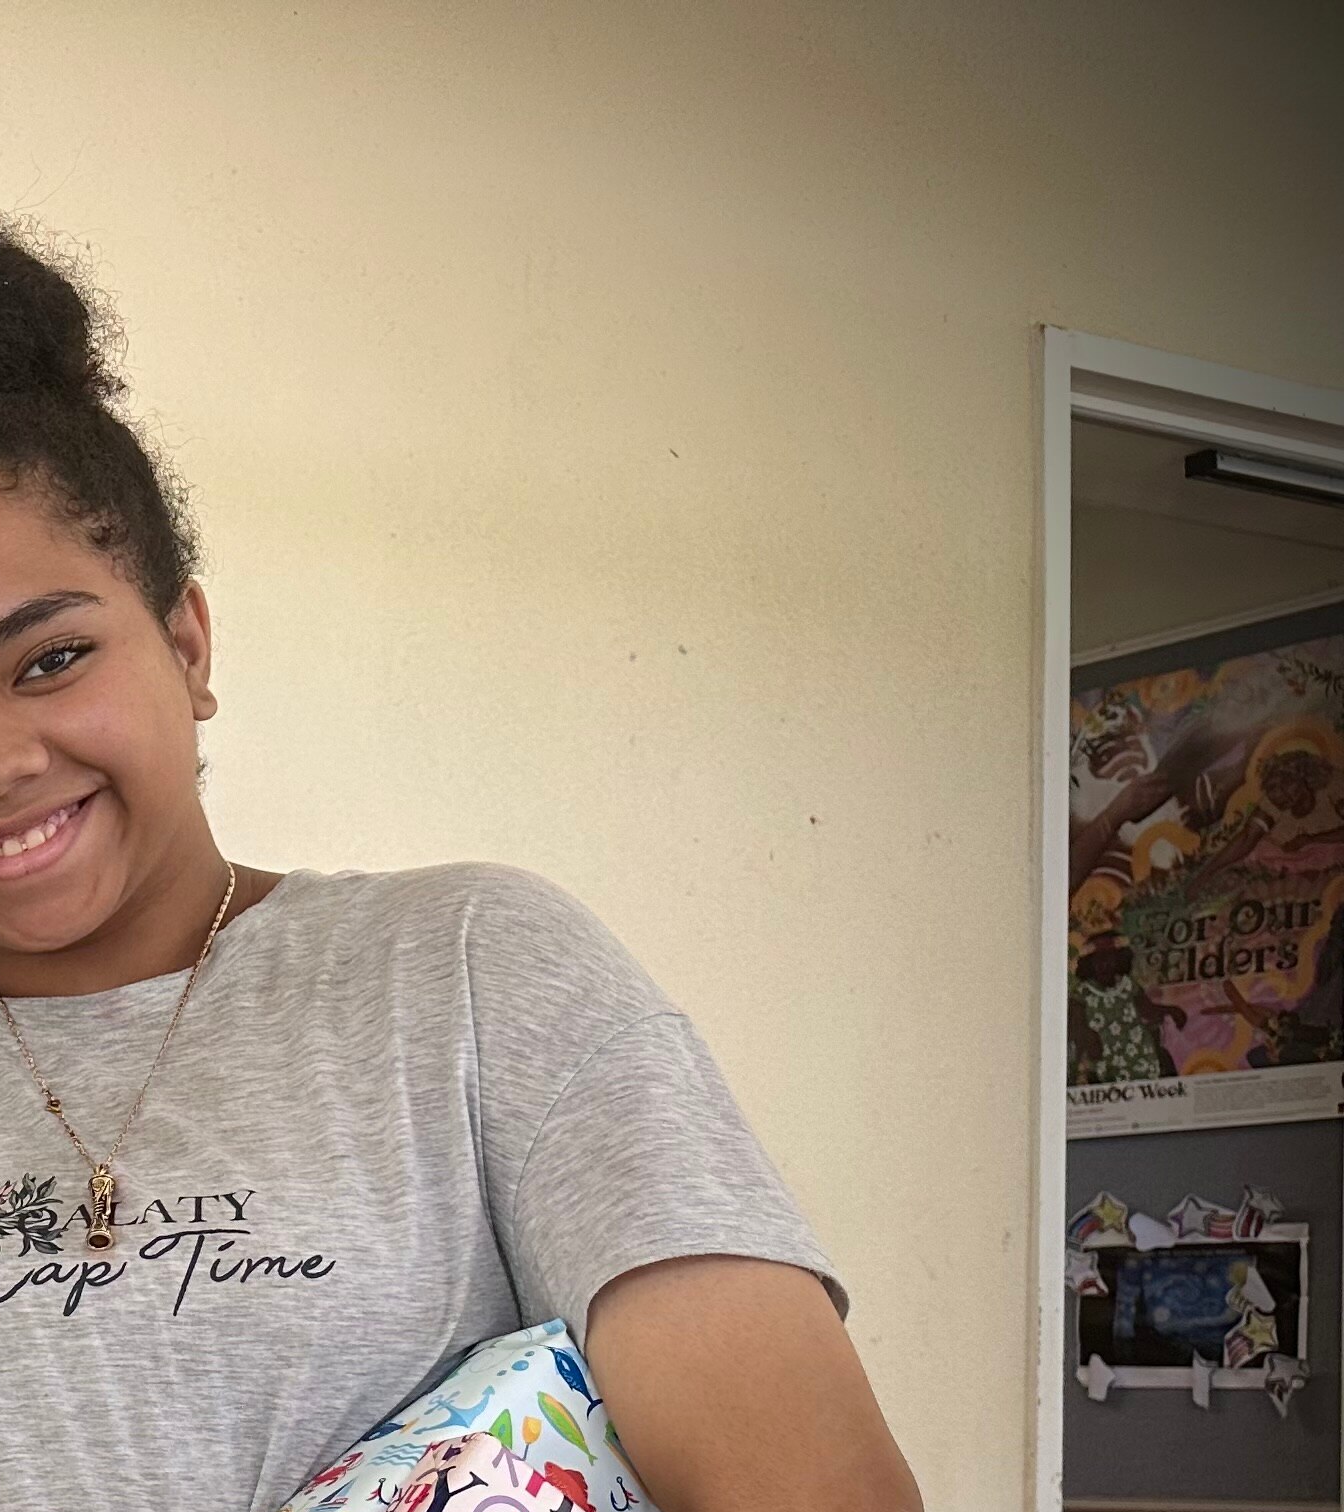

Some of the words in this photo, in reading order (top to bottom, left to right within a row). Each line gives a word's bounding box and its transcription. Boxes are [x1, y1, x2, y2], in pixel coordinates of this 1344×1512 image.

[1131, 911, 1217, 948] For
[1230, 899, 1322, 936] Our
[1146, 935, 1299, 985] Elders
[1139, 1081, 1188, 1100] Week
[138, 1228, 336, 1317] Time
